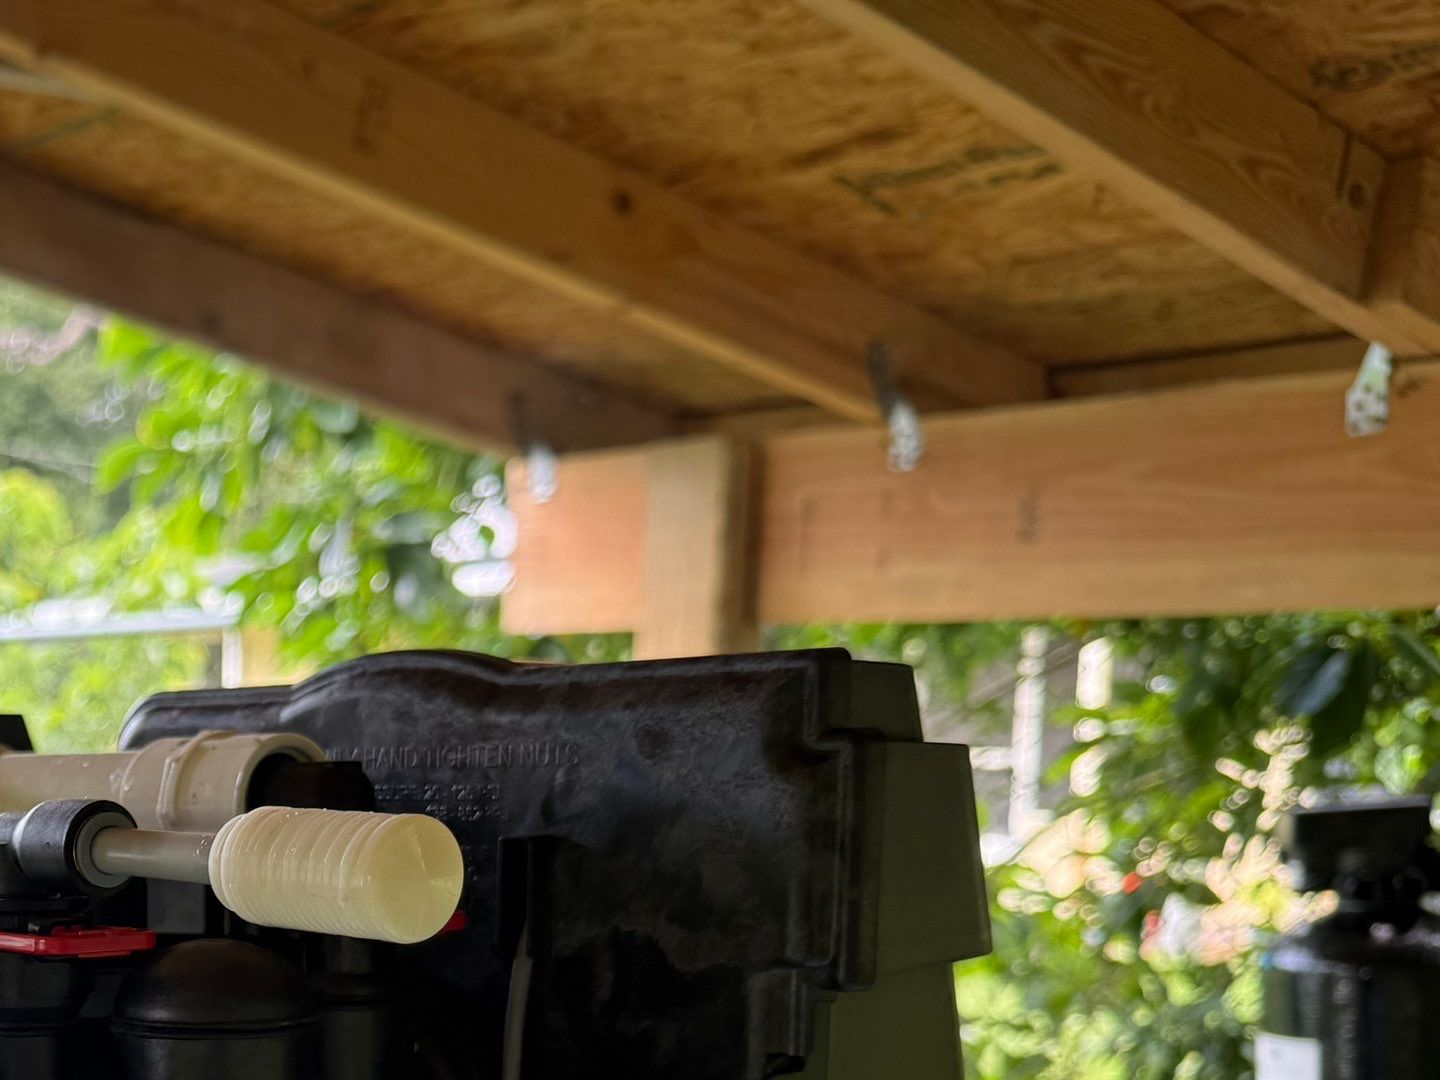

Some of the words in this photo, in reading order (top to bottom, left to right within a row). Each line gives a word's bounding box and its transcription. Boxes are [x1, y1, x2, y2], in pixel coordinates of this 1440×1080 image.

[362, 746, 417, 768] HAND
[424, 745, 511, 768] TIGHTEN
[519, 743, 579, 767] NUTS
